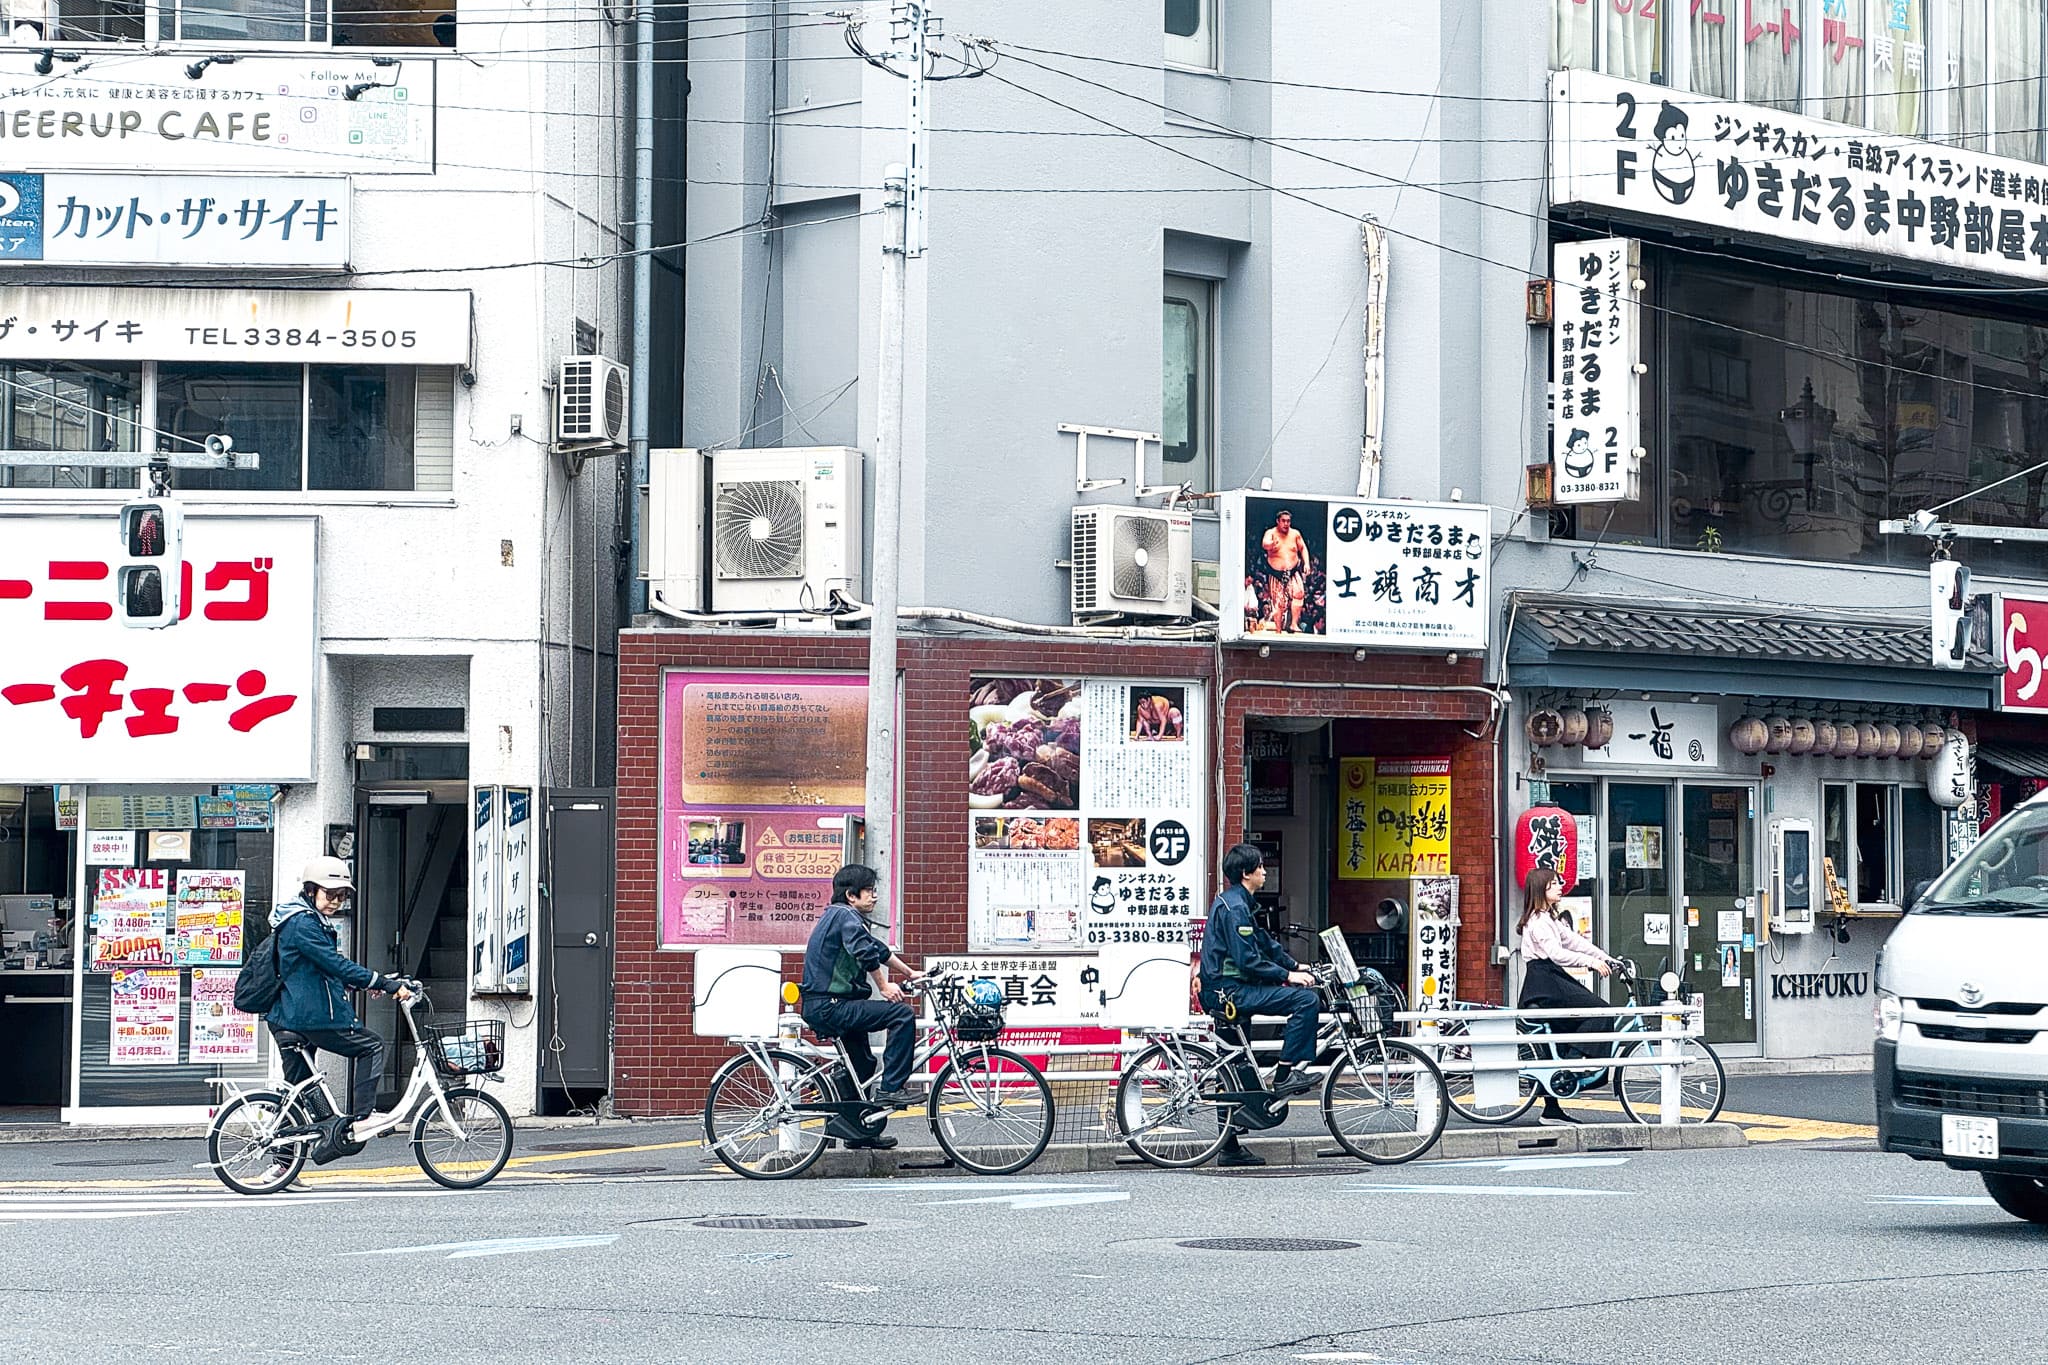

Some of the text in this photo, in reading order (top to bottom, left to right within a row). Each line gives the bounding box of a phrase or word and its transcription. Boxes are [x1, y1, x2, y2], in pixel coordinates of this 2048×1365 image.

[311, 71, 377, 81] Follow Me!
[158, 110, 271, 141] CAFE
[52, 195, 338, 242] カット・ザ・サイキ
[1608, 250, 1620, 345] ジンギスカン
[1578, 252, 1603, 416] ゆきだるま
[1562, 321, 1575, 420] 中野部屋本店
[1560, 482, 1620, 493] 03-3380-8321
[1366, 509, 1412, 521] ジンギスカン
[1336, 516, 1361, 534] 2F
[1365, 521, 1464, 547] ゆきだるま
[1402, 546, 1463, 560] 中野部屋本店
[762, 833, 776, 845] 3F
[1155, 837, 1186, 859] 2F
[1376, 853, 1449, 872] KARATE
[511, 871, 520, 895] ザ
[1118, 873, 1176, 884] ジンギスカン
[694, 890, 720, 899] フリー
[1119, 886, 1190, 901] ゆきだるま
[1127, 904, 1190, 916] 中野部屋本店
[1421, 929, 1435, 938] 2F
[980, 960, 1057, 971] 全世界空手道連盟
[140, 986, 177, 1000] 990円
[937, 974, 1058, 1007] 新真会
[1770, 972, 1869, 999] ICHIFUKU
